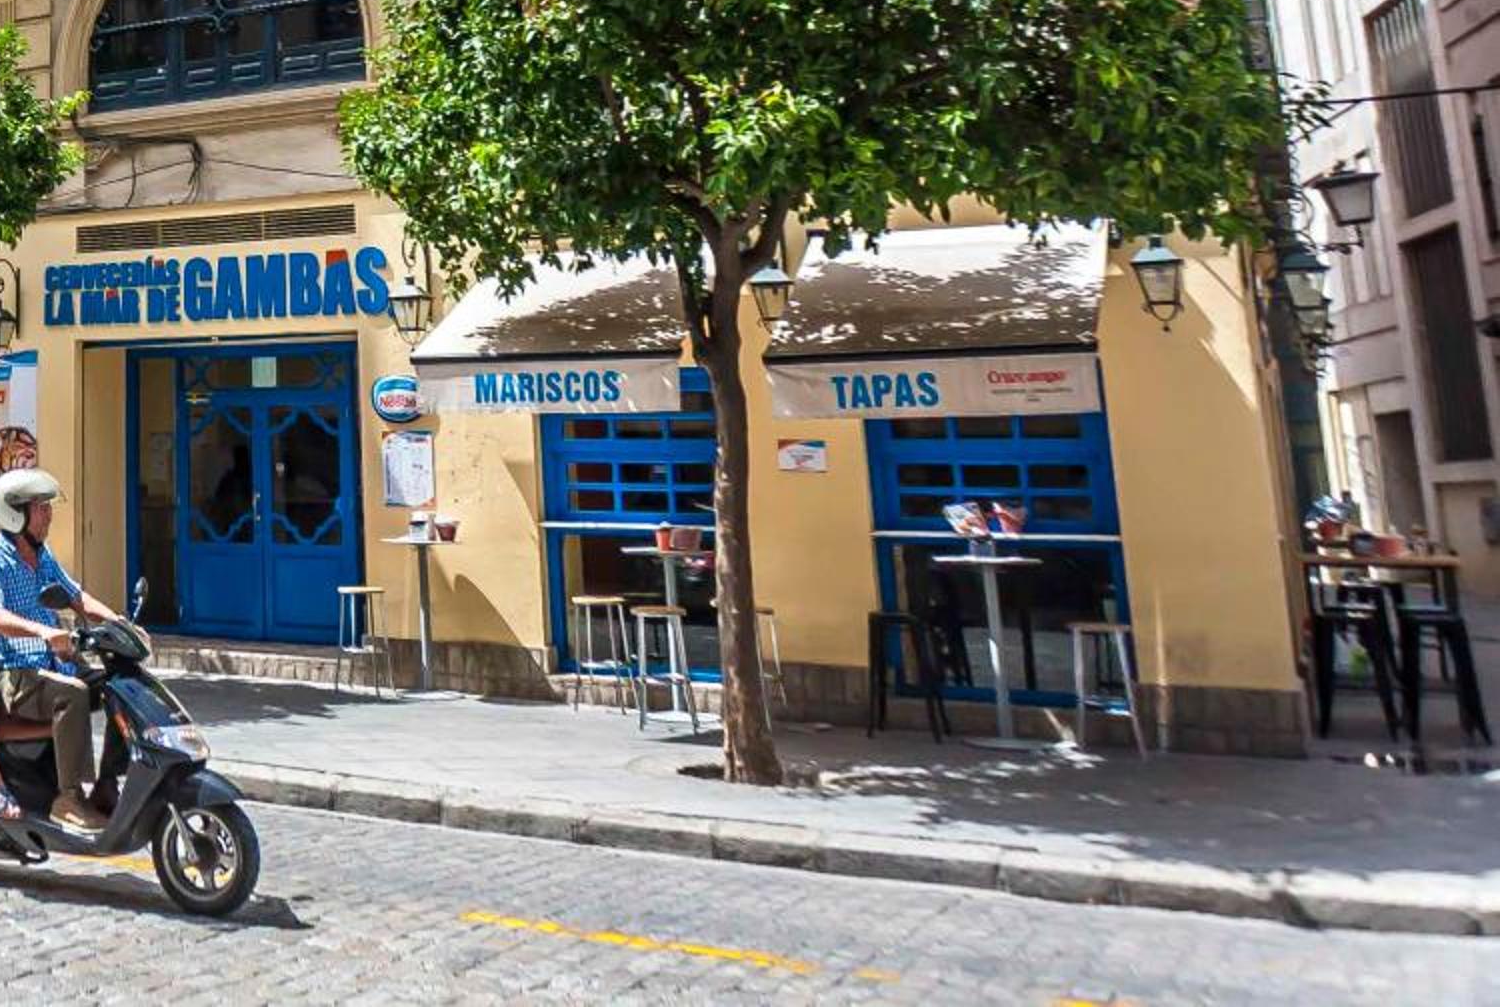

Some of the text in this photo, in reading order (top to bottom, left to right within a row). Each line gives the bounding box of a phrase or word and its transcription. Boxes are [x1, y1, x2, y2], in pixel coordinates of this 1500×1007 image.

[44, 246, 390, 326] LA MAR DE GAMBAS
[474, 369, 621, 404] MARISCOS
[831, 370, 940, 409] TAPAS
